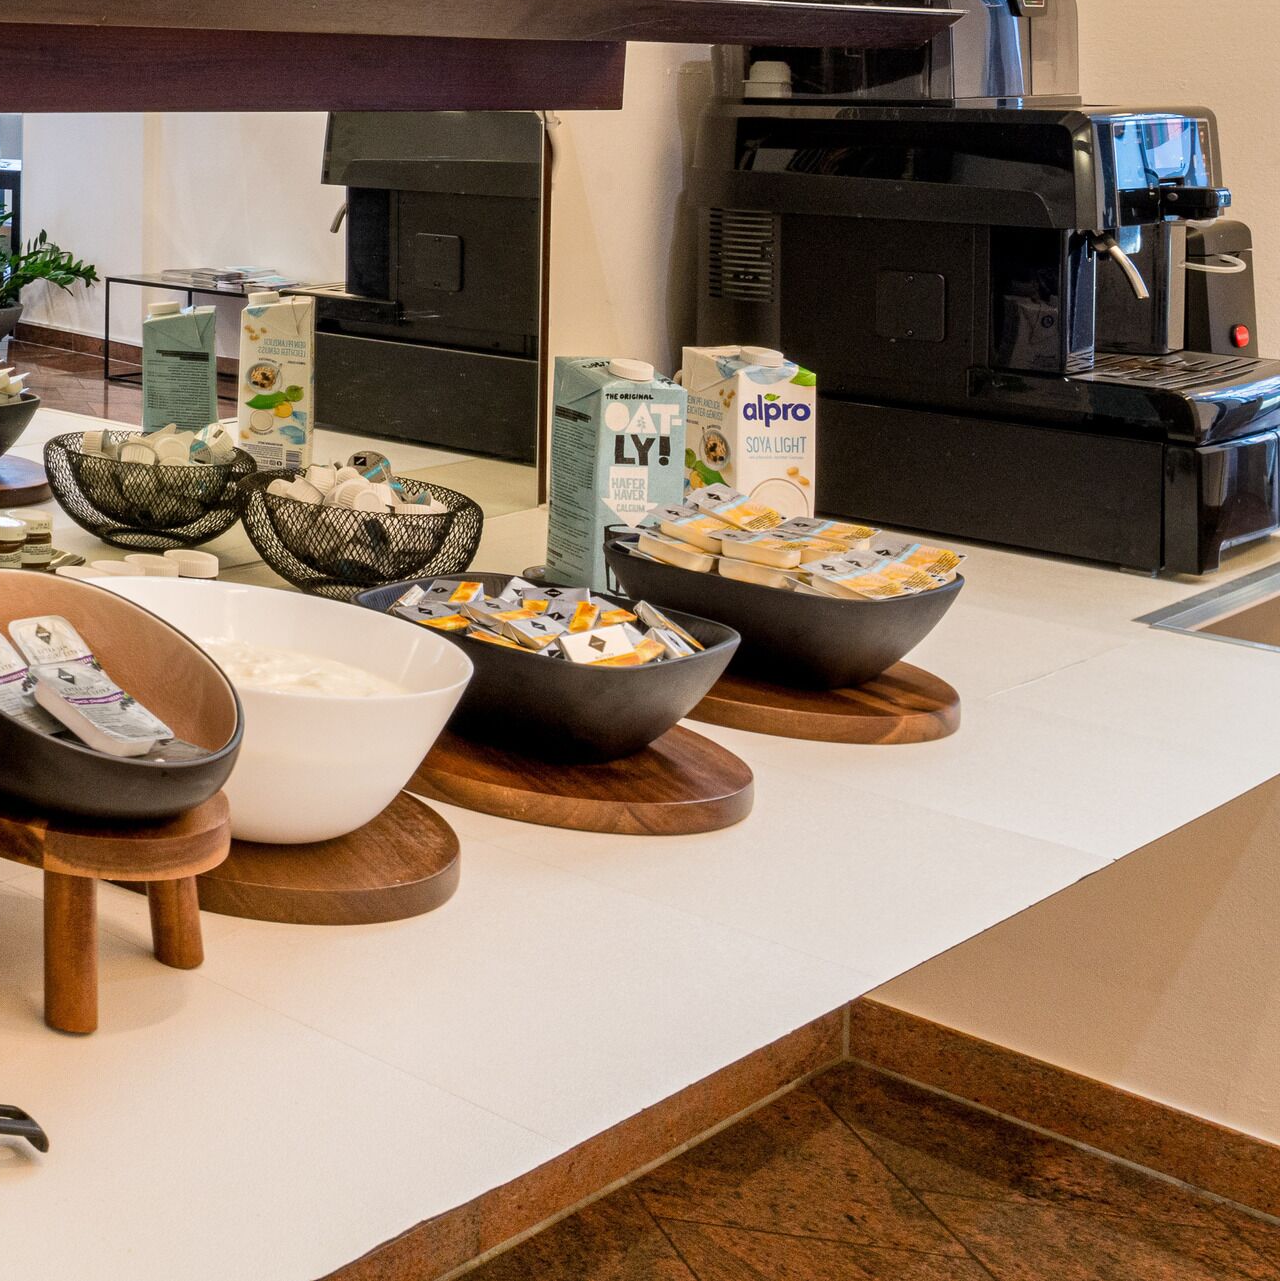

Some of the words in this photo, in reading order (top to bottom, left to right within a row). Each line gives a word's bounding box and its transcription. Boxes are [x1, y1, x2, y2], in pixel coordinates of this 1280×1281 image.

[620, 393, 654, 401] ORIGINAL
[742, 395, 812, 427] alpro
[614, 433, 671, 467] LY!
[746, 436, 773, 454] SOYA
[774, 436, 808, 455] LIGHT
[611, 477, 646, 490] HAFER
[614, 490, 646, 502] HAVER
